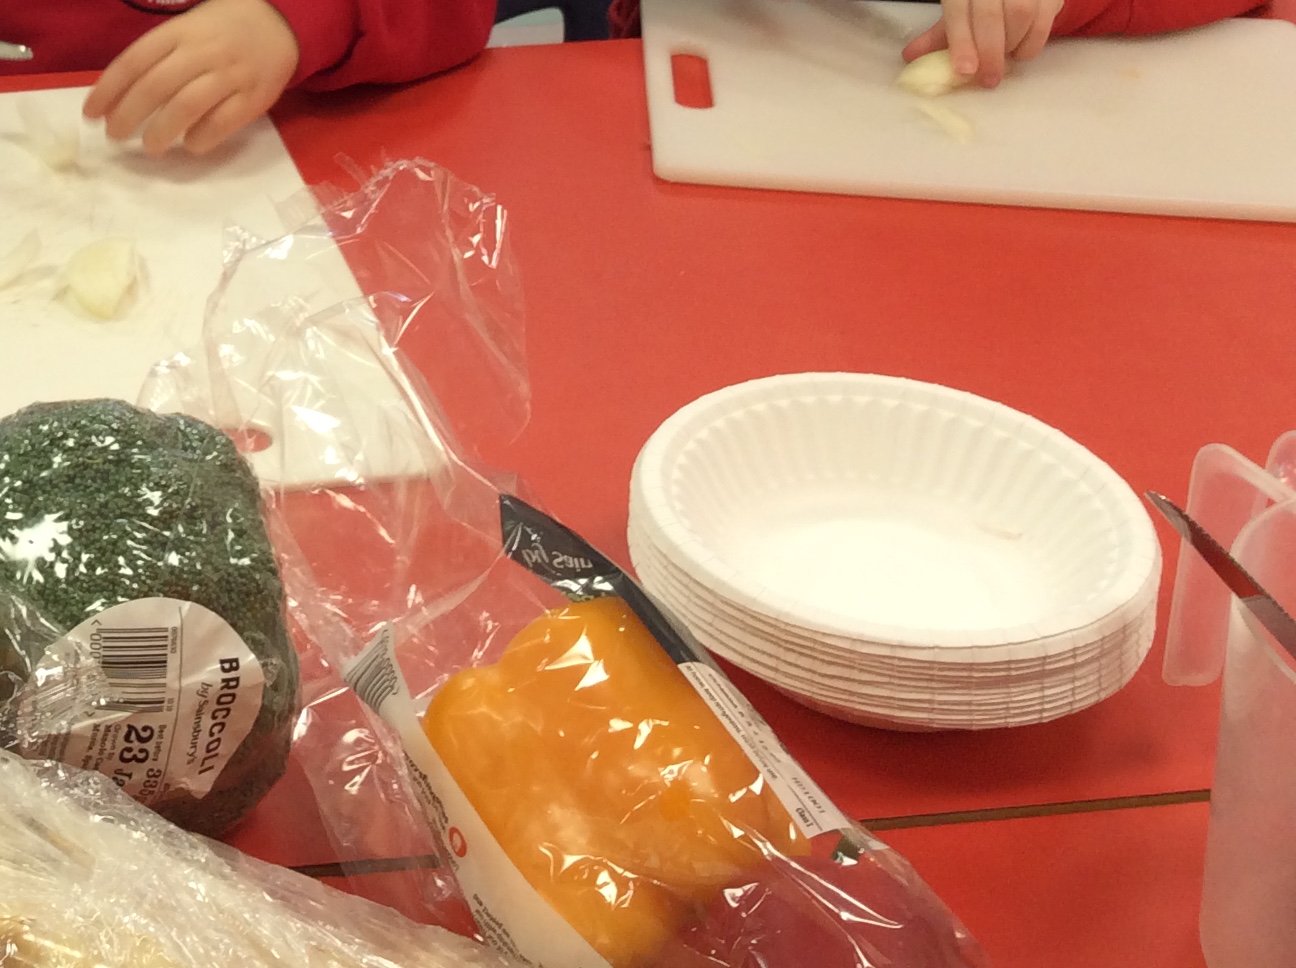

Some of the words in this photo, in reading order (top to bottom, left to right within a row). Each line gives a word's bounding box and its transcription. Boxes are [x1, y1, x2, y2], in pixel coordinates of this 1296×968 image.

[196, 682, 213, 700] by
[186, 698, 210, 766] Sainsbury's
[198, 657, 240, 775] BROCCOLI
[118, 723, 153, 763] 23
[112, 767, 132, 787] Ja
